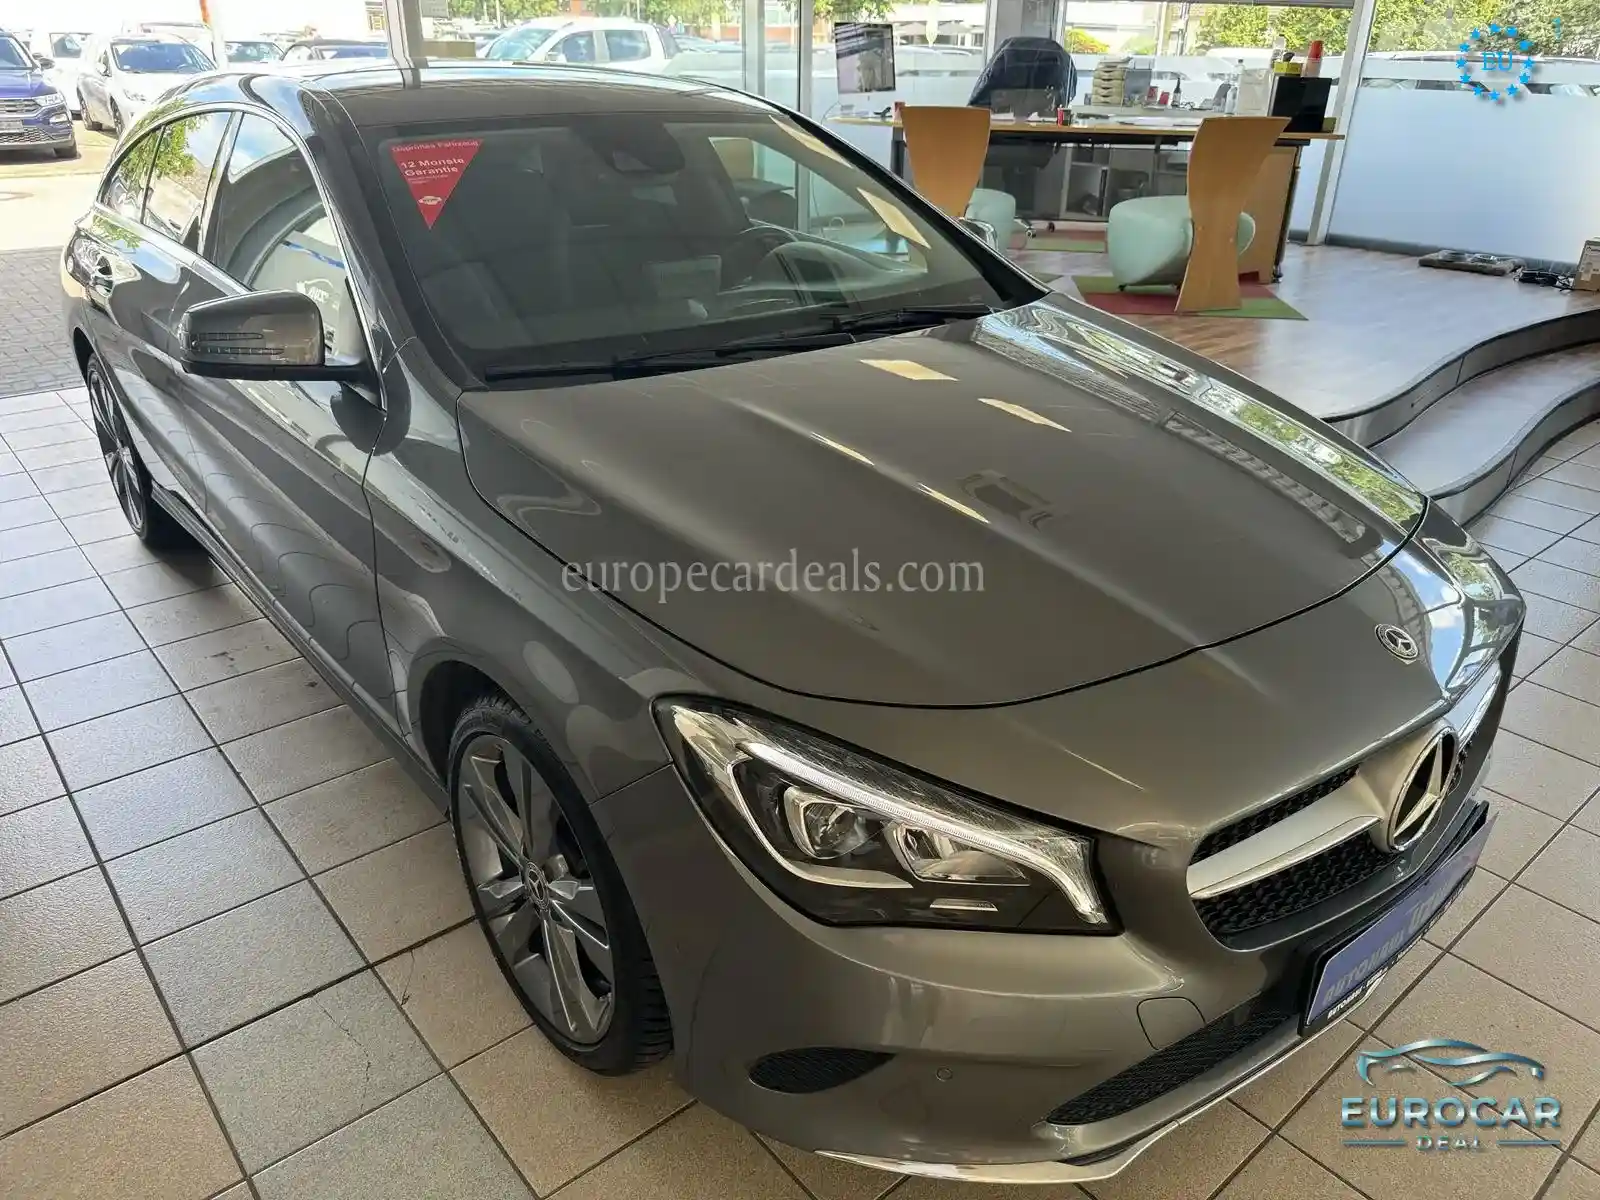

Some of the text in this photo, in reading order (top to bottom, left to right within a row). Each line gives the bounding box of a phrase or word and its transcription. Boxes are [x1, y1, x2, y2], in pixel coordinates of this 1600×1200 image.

[401, 157, 465, 169] 12 Monate
[404, 166, 458, 177] Garantie
